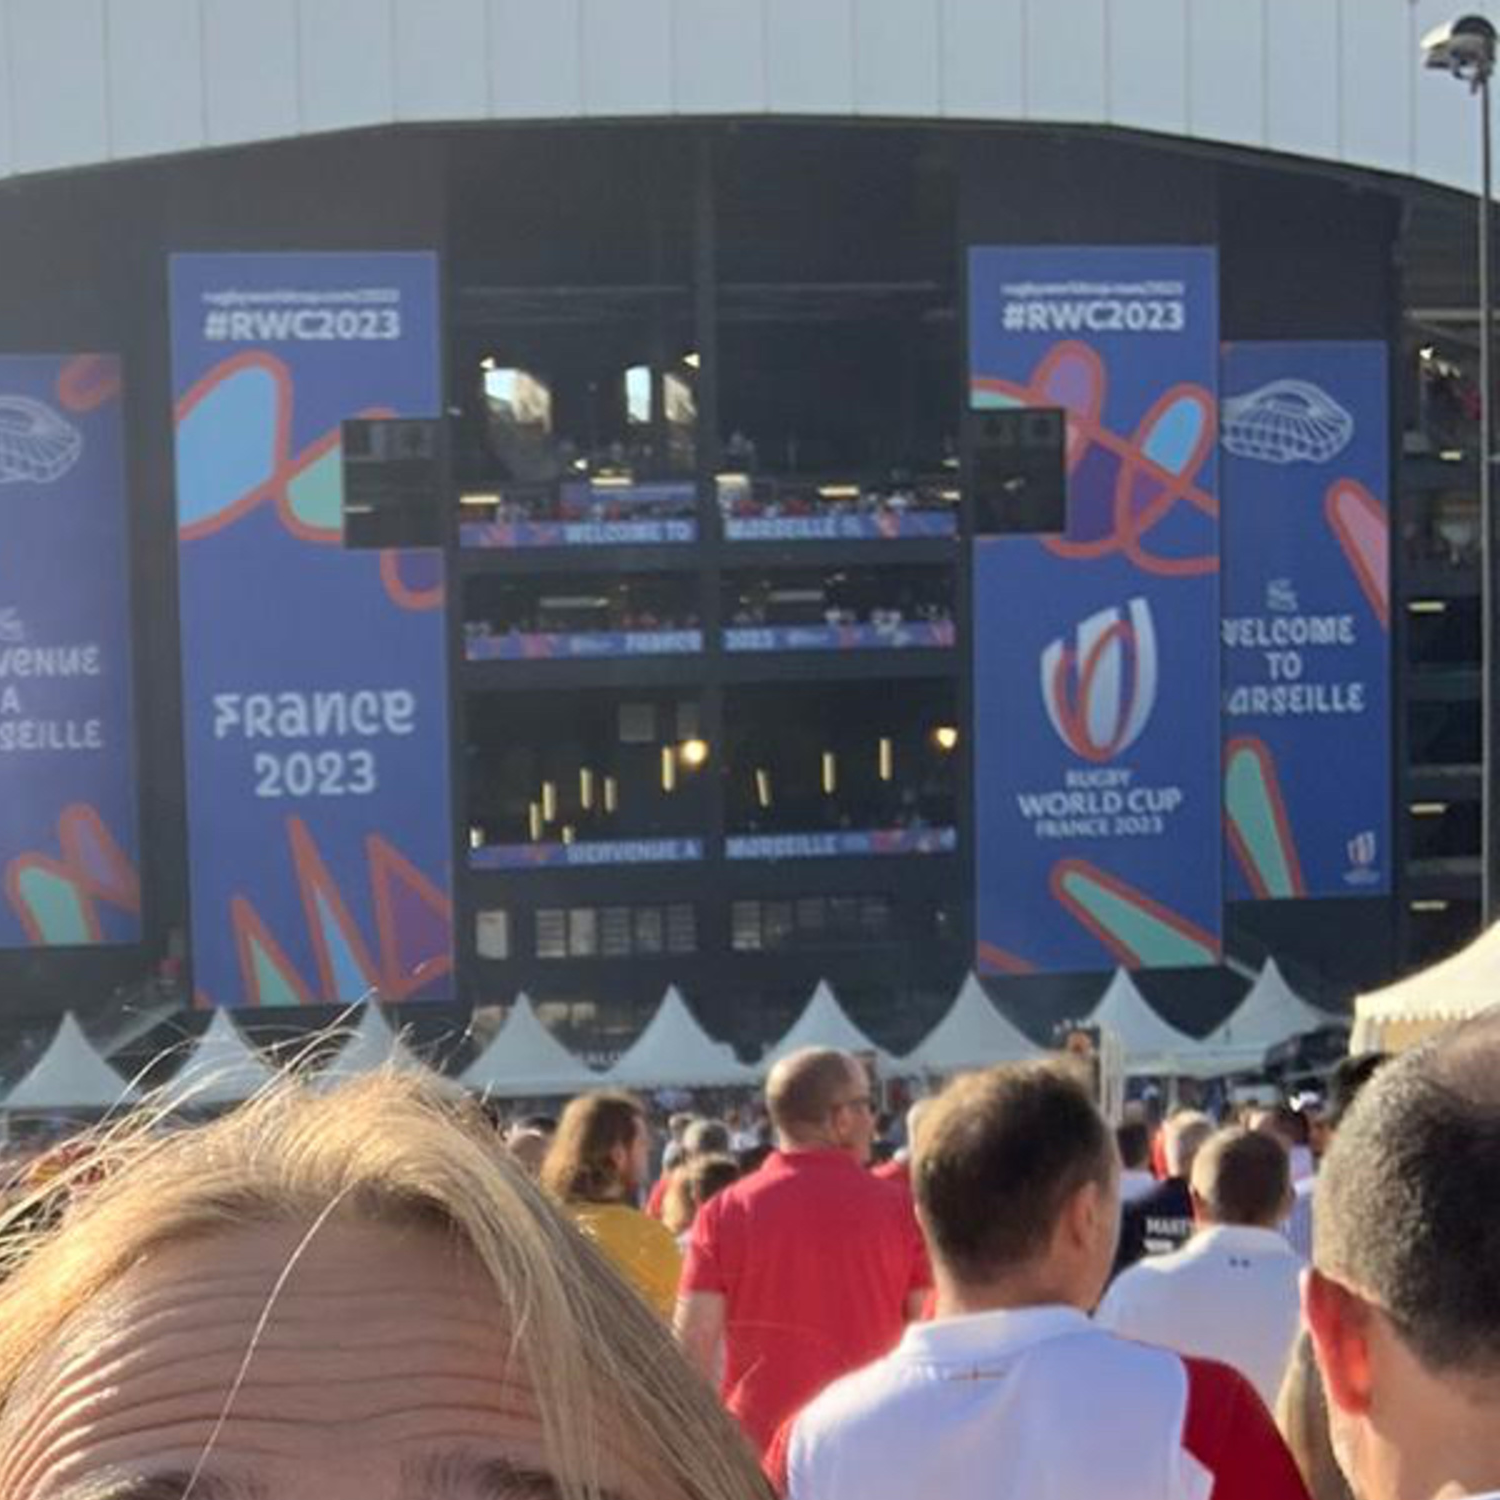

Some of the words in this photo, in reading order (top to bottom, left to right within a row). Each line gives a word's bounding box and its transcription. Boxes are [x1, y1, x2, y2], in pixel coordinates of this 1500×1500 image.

[204, 308, 401, 341] #RWC2023
[1002, 300, 1185, 331] #RWC2023
[1221, 615, 1356, 647] WELCOME
[1265, 650, 1303, 680] TO
[0, 683, 21, 715] A
[1221, 682, 1366, 716] ARSEILLE
[255, 750, 376, 797] 2023
[1016, 789, 1122, 819] WORLD
[1127, 785, 1182, 814] CUP
